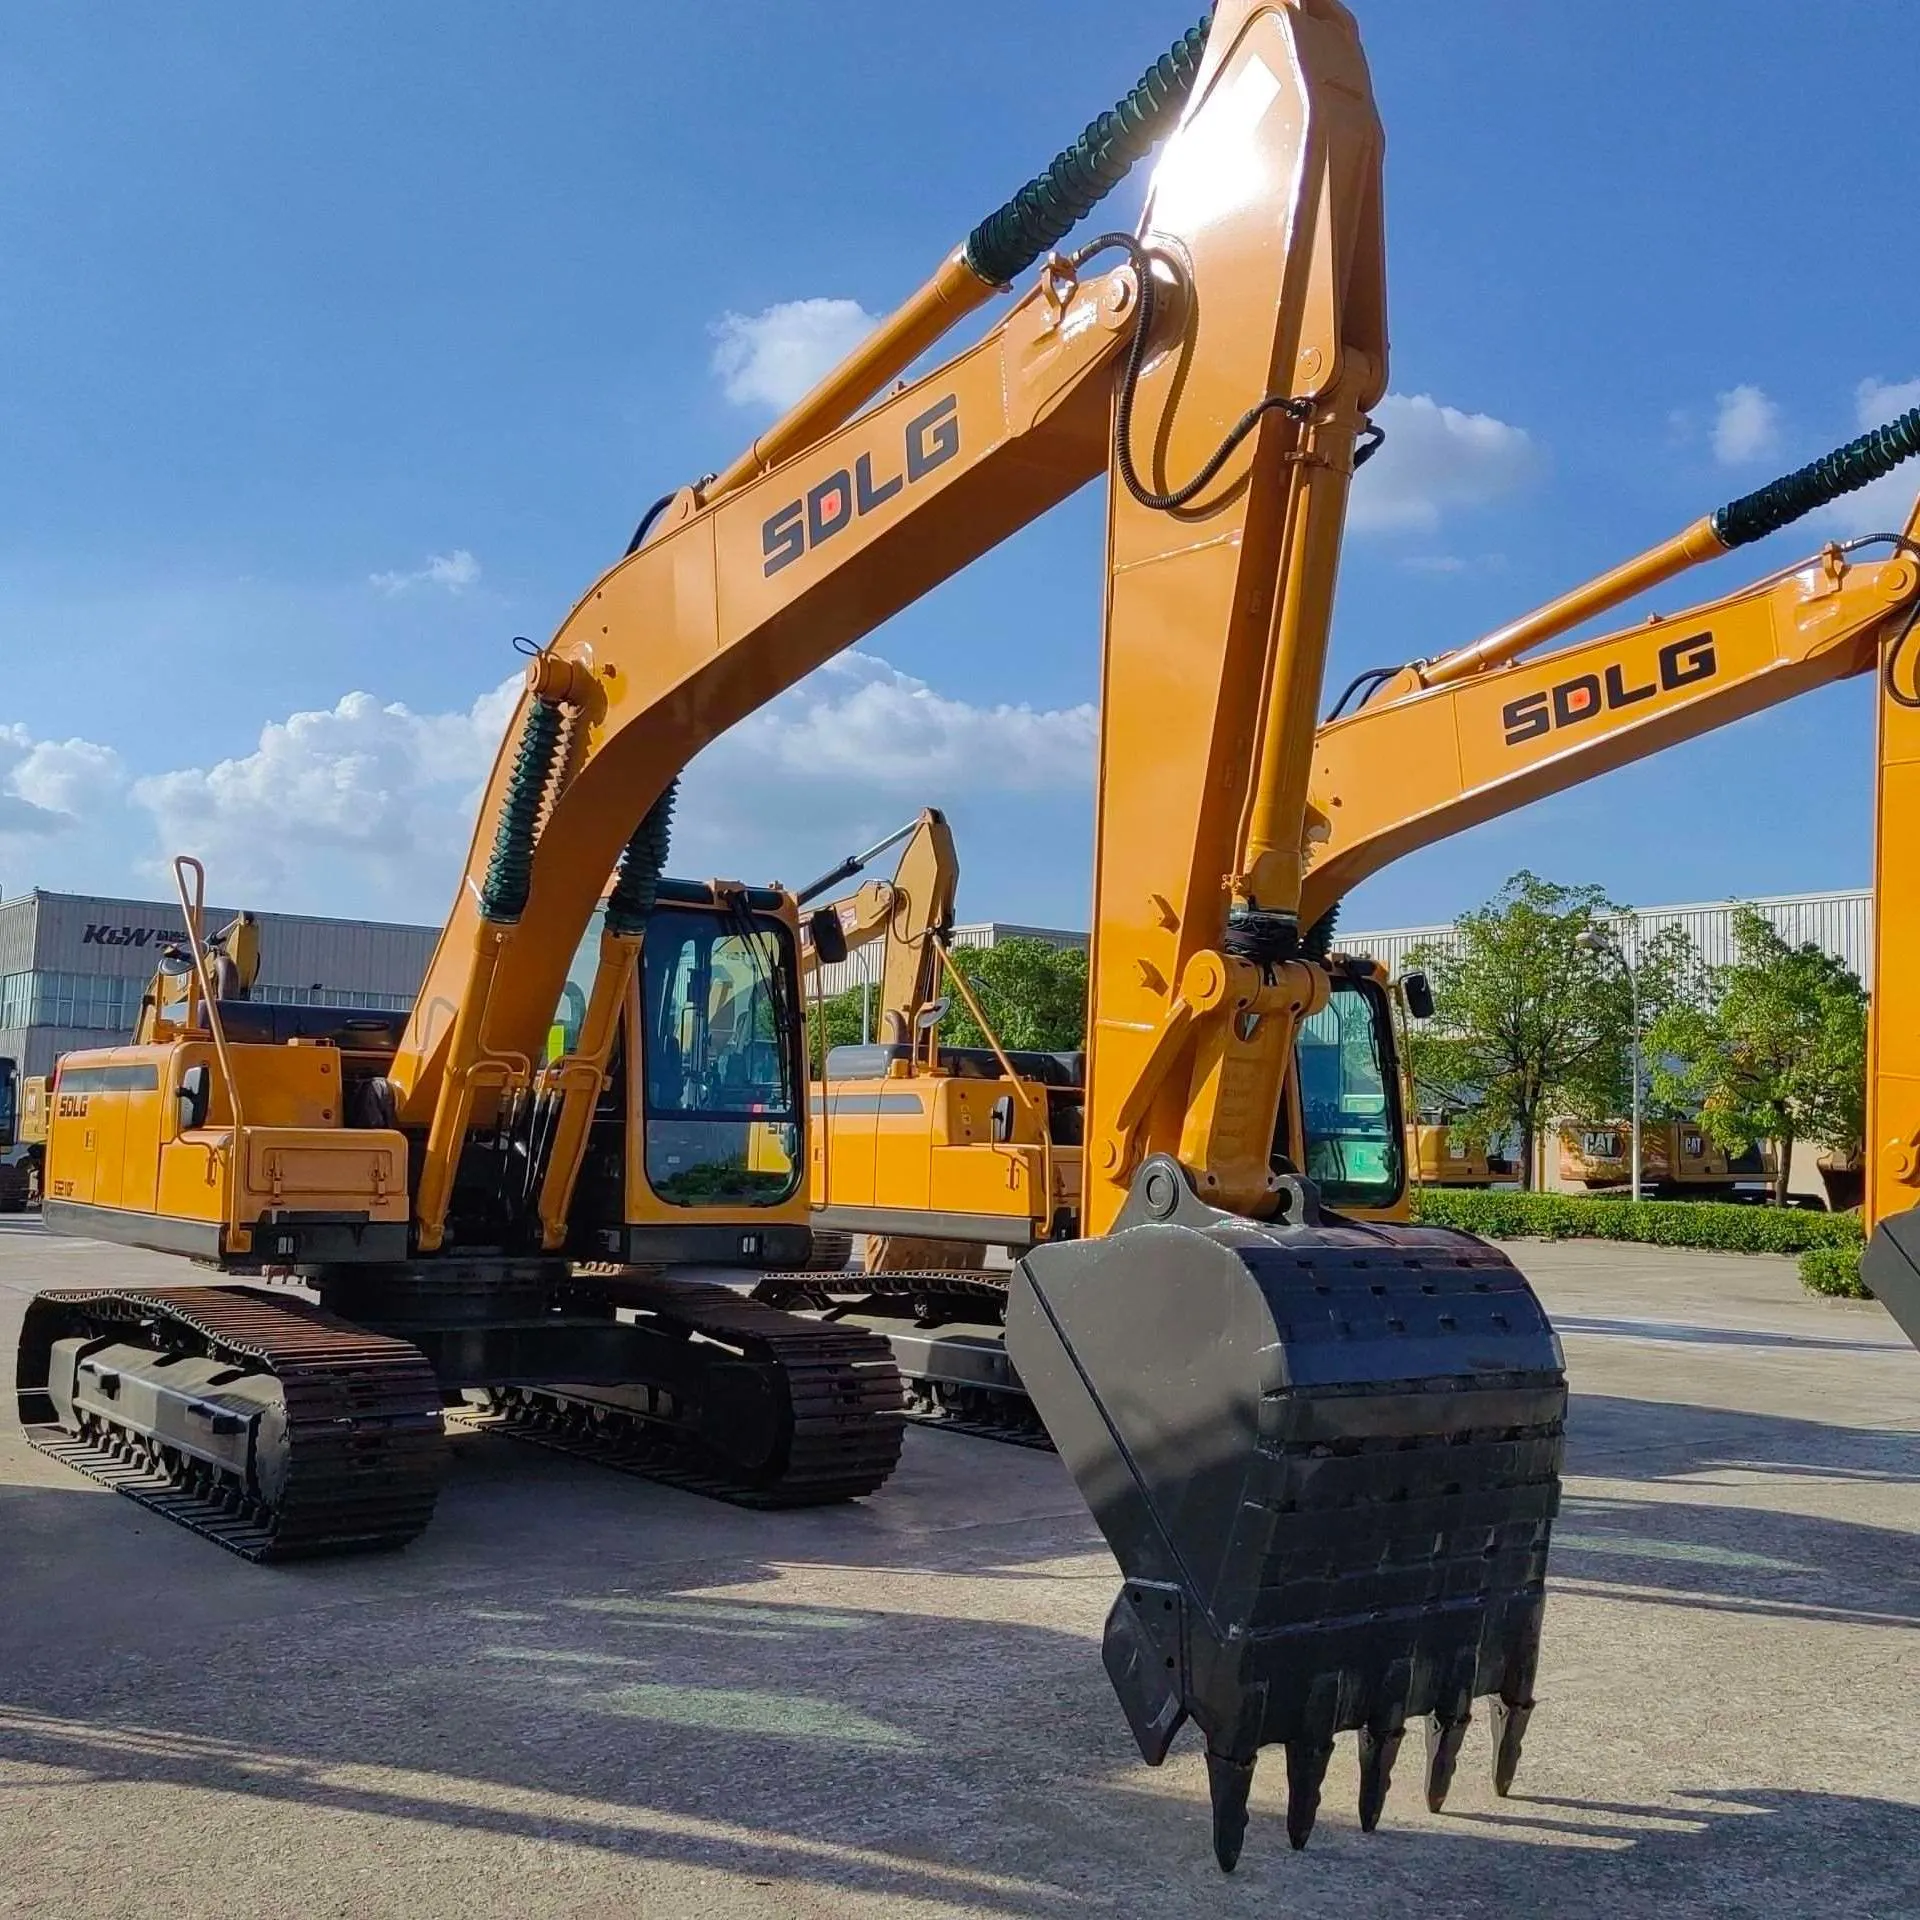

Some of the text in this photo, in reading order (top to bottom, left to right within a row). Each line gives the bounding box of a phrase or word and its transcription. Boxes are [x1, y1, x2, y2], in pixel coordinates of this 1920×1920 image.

[762, 393, 959, 578] SDLG
[1502, 631, 1717, 746] SDLG
[60, 1095, 88, 1117] SDLG
[1584, 1132, 1616, 1155] CAT
[1685, 1136, 1701, 1153] CAT
